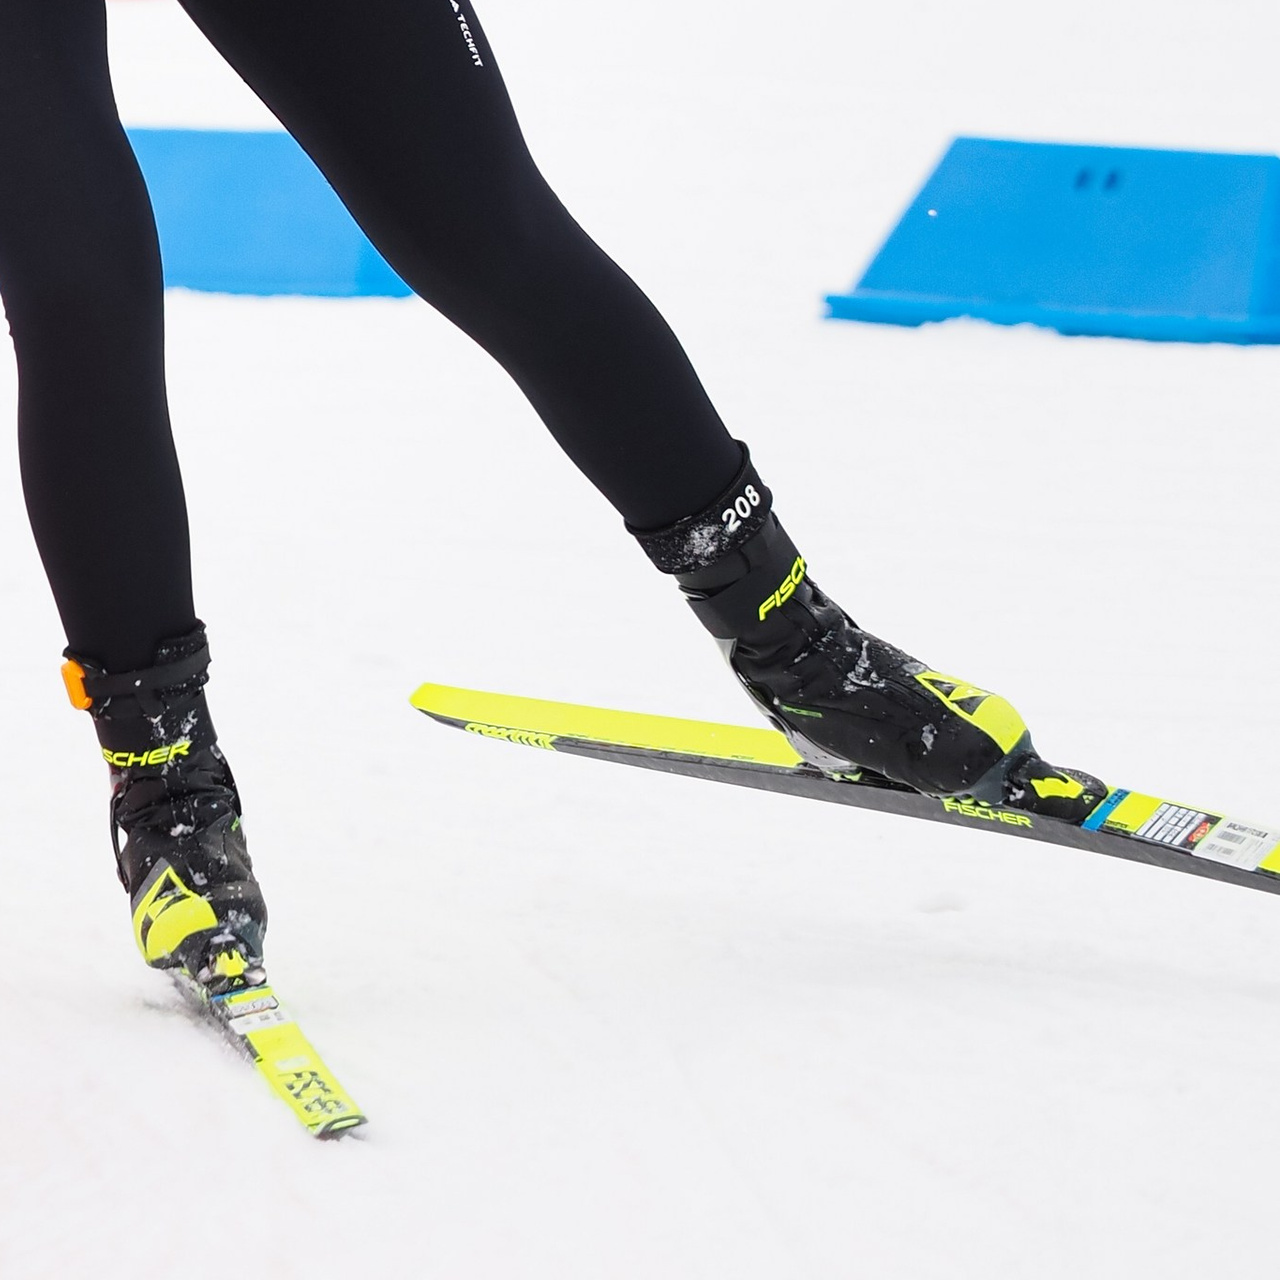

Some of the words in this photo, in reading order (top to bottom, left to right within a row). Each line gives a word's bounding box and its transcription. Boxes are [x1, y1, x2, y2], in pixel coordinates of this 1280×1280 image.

[457, 13, 484, 67] TECHFIT
[721, 484, 760, 533] 208
[943, 800, 1034, 829] FISCHER
